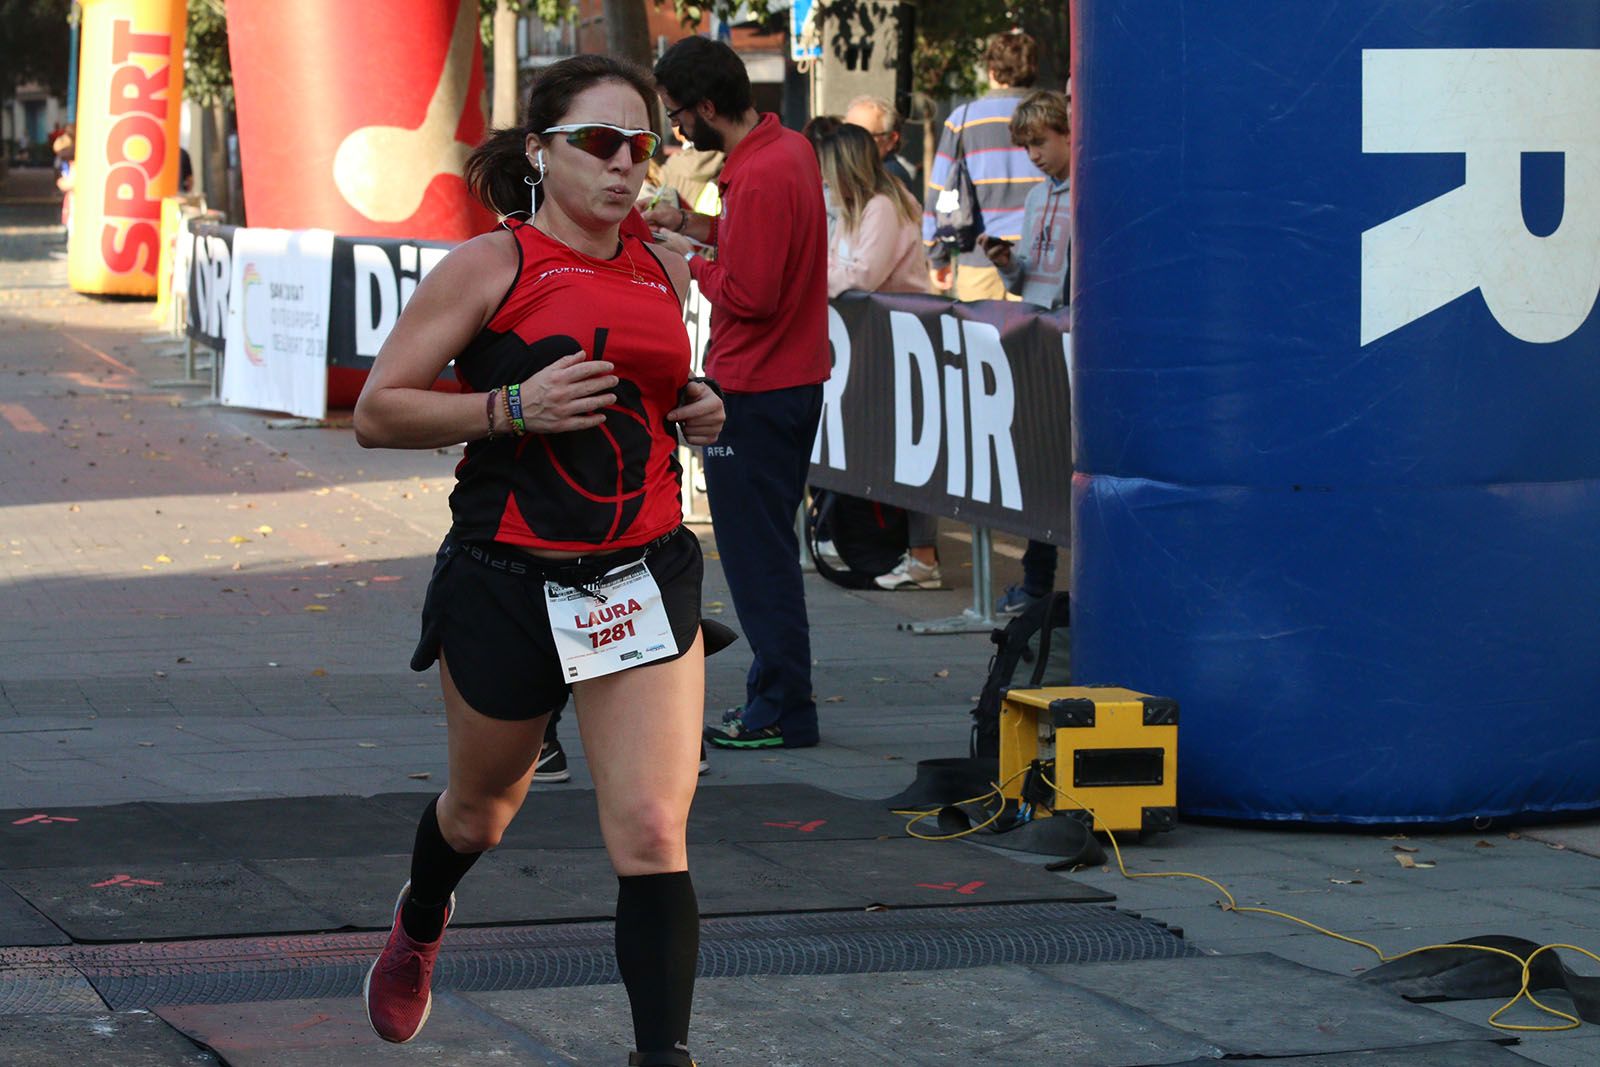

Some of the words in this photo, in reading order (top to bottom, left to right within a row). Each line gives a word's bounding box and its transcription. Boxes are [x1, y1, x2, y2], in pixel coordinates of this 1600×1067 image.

[101, 20, 171, 277] SPORT
[1361, 48, 1600, 347] R
[353, 244, 452, 357] Di
[707, 446, 735, 457] RFEA
[890, 310, 1023, 511] DiR
[574, 598, 643, 629] LAURA
[588, 620, 637, 649] 1281
